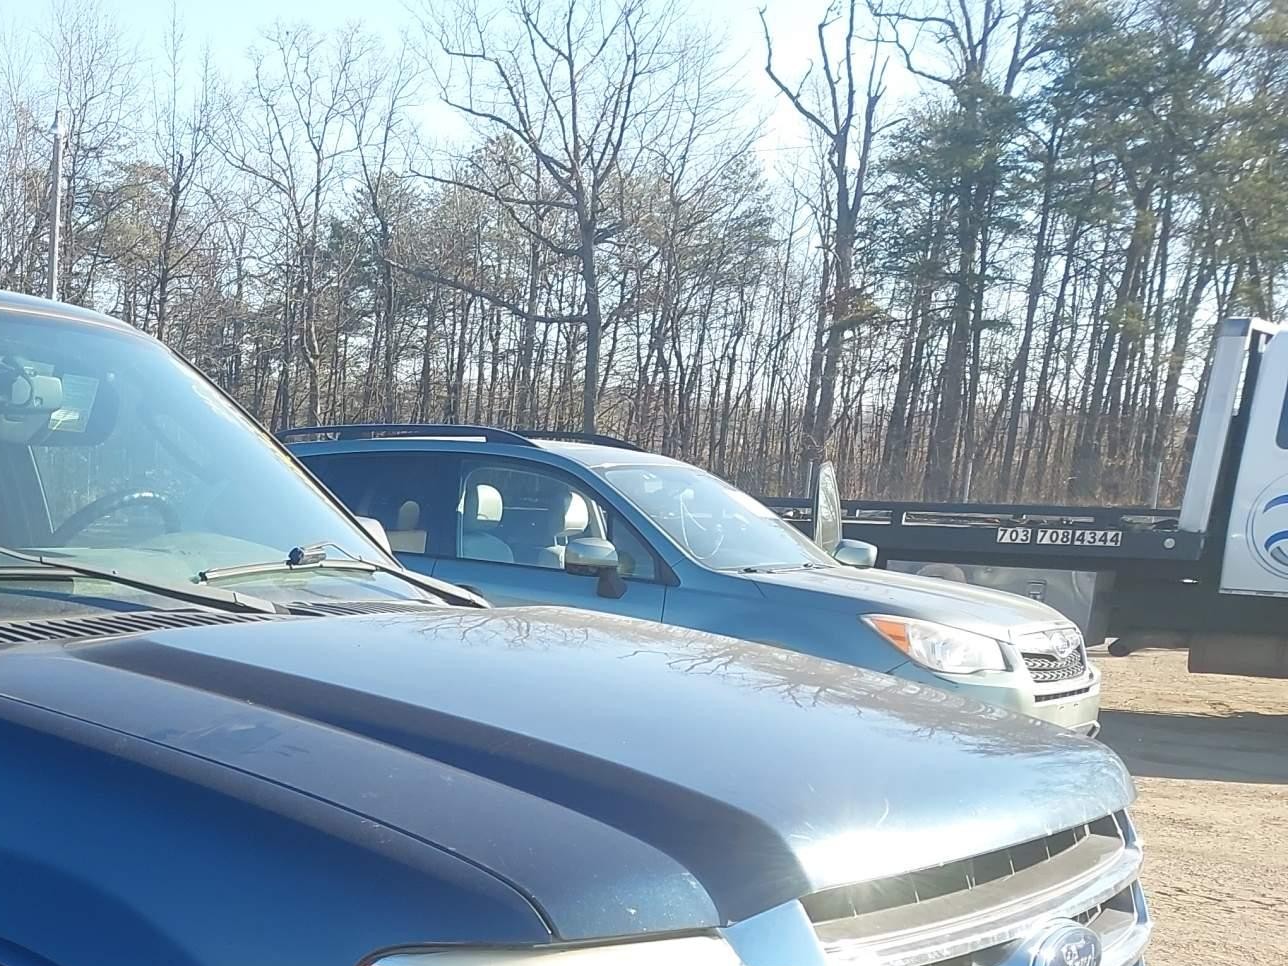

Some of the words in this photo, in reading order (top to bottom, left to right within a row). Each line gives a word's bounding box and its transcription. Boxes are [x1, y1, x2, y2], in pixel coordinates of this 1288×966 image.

[998, 528, 1030, 542] 703
[1039, 529, 1070, 543] 708
[1075, 531, 1120, 546] 4344
